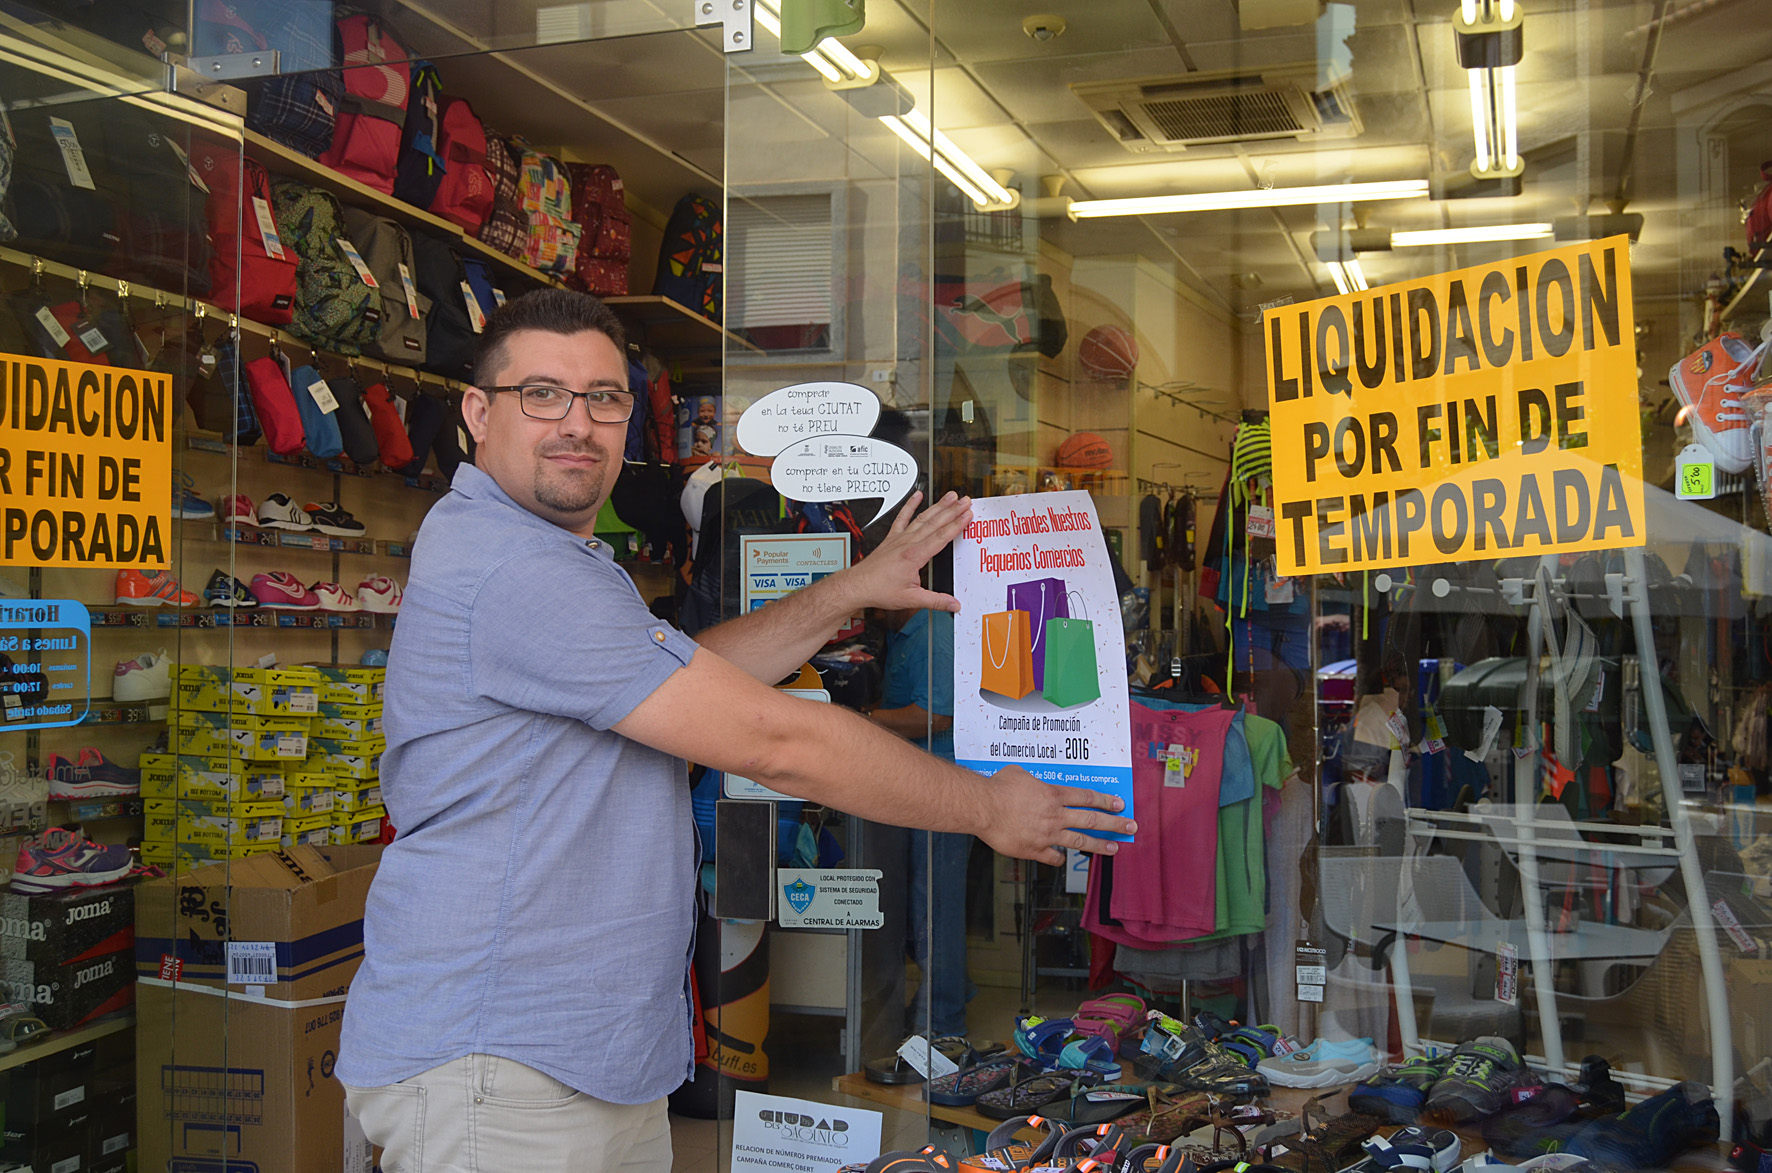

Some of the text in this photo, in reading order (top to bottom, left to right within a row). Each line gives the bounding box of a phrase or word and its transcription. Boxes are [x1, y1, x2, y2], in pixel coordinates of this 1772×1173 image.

[1271, 247, 1621, 404] LIQUIDACION
[0, 359, 165, 442] IDACION
[787, 389, 830, 404] comprar
[761, 402, 862, 416] en la teua CIUTAT
[778, 420, 838, 433] no té PREU
[1304, 381, 1589, 483] POR FIN DE
[857, 444, 869, 453] afic
[25, 449, 85, 499] FIN
[99, 455, 142, 502] DE
[785, 462, 909, 481] comprar en tu CIUDAD
[802, 480, 891, 493] no tiene PRECIO
[1010, 508, 1050, 535] Grandes
[1047, 505, 1092, 532] Nuestros
[1281, 463, 1635, 568] TEMPORADA
[0, 507, 165, 564] PORADA
[756, 557, 789, 566] Payments
[980, 543, 1086, 578] Pequeños Comercios
[754, 579, 776, 588] VISA
[784, 577, 806, 587] VISA
[998, 715, 1081, 733] Campaña de Promoción
[990, 742, 1001, 757] del
[1002, 742, 1035, 758] Comercio
[1037, 743, 1057, 759] Local
[1065, 737, 1089, 760] 2016
[1034, 771, 1043, 780] de
[1043, 770, 1056, 780] 500
[1065, 774, 1079, 783] para
[1080, 774, 1090, 782] tus
[1091, 775, 1120, 784] compras.
[790, 892, 810, 902] CECA
[66, 900, 112, 925] Joma
[803, 918, 834, 926] CENTRAL
[845, 919, 880, 927] ALARMAS
[74, 960, 114, 989] Joma
[759, 1109, 849, 1132] CIUDAD
[735, 1144, 765, 1154] RELACION
[775, 1147, 805, 1160] NÚMEROS
[806, 1153, 842, 1165] PREMIADOS
[736, 1155, 814, 1173] CAMPAÑA COMERÇ OBERT
